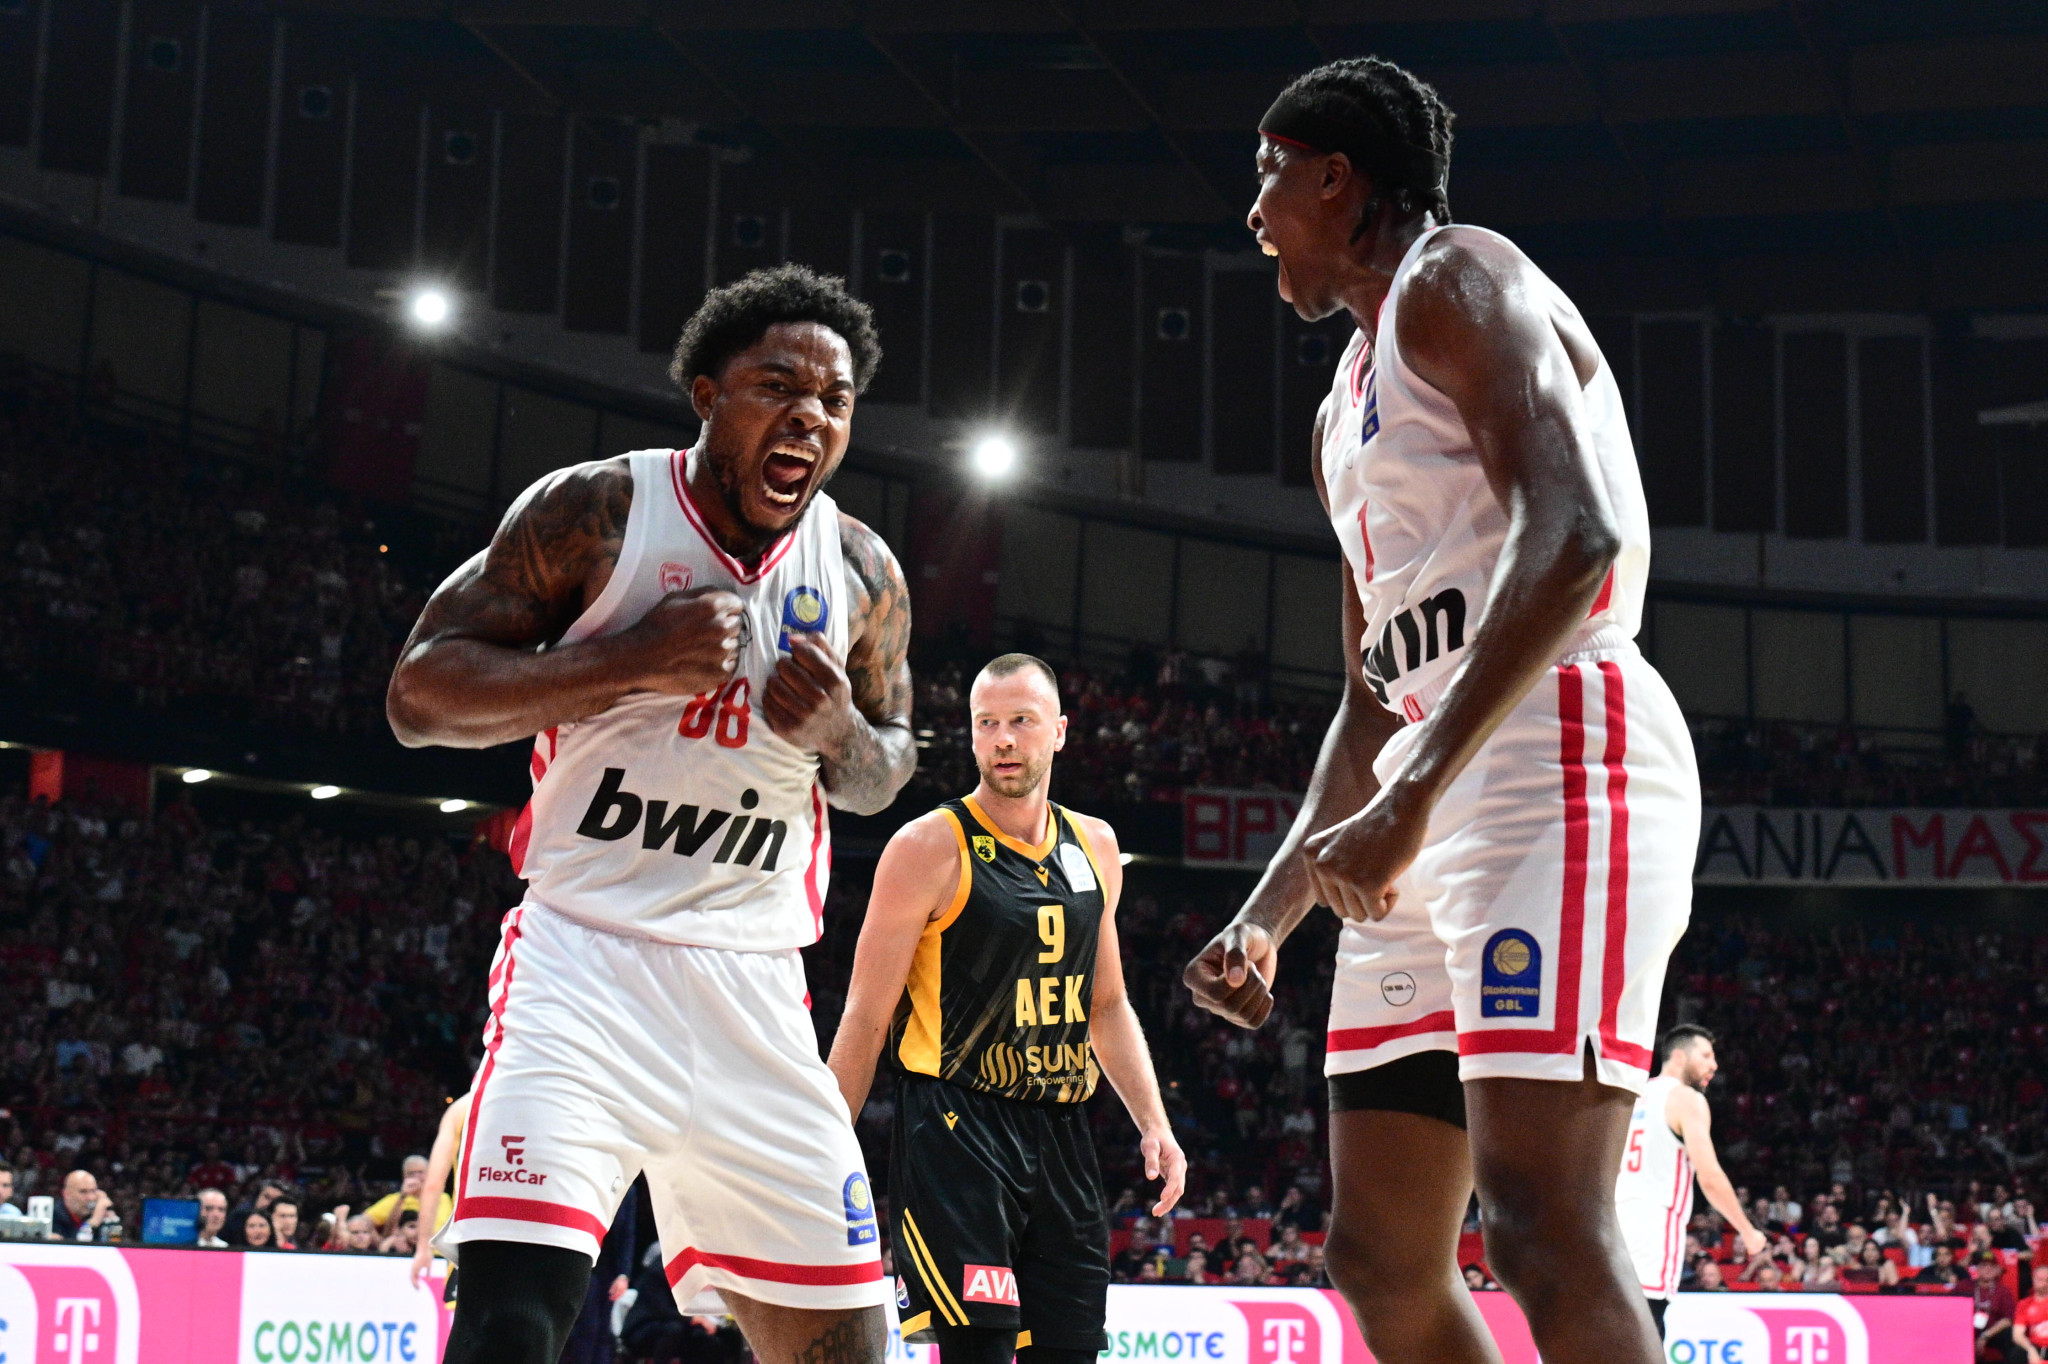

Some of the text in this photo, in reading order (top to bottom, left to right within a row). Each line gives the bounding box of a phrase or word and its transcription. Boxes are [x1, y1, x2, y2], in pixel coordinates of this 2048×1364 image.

[576, 767, 788, 872] bwin
[1037, 904, 1066, 964] 9
[1015, 974, 1087, 1028] AEK
[1495, 998, 1524, 1011] GBL
[1026, 1075, 1084, 1087] Empowering
[1626, 1128, 1645, 1173] 5
[478, 1166, 548, 1186] FlexCar
[254, 1320, 417, 1364] COSMOTE
